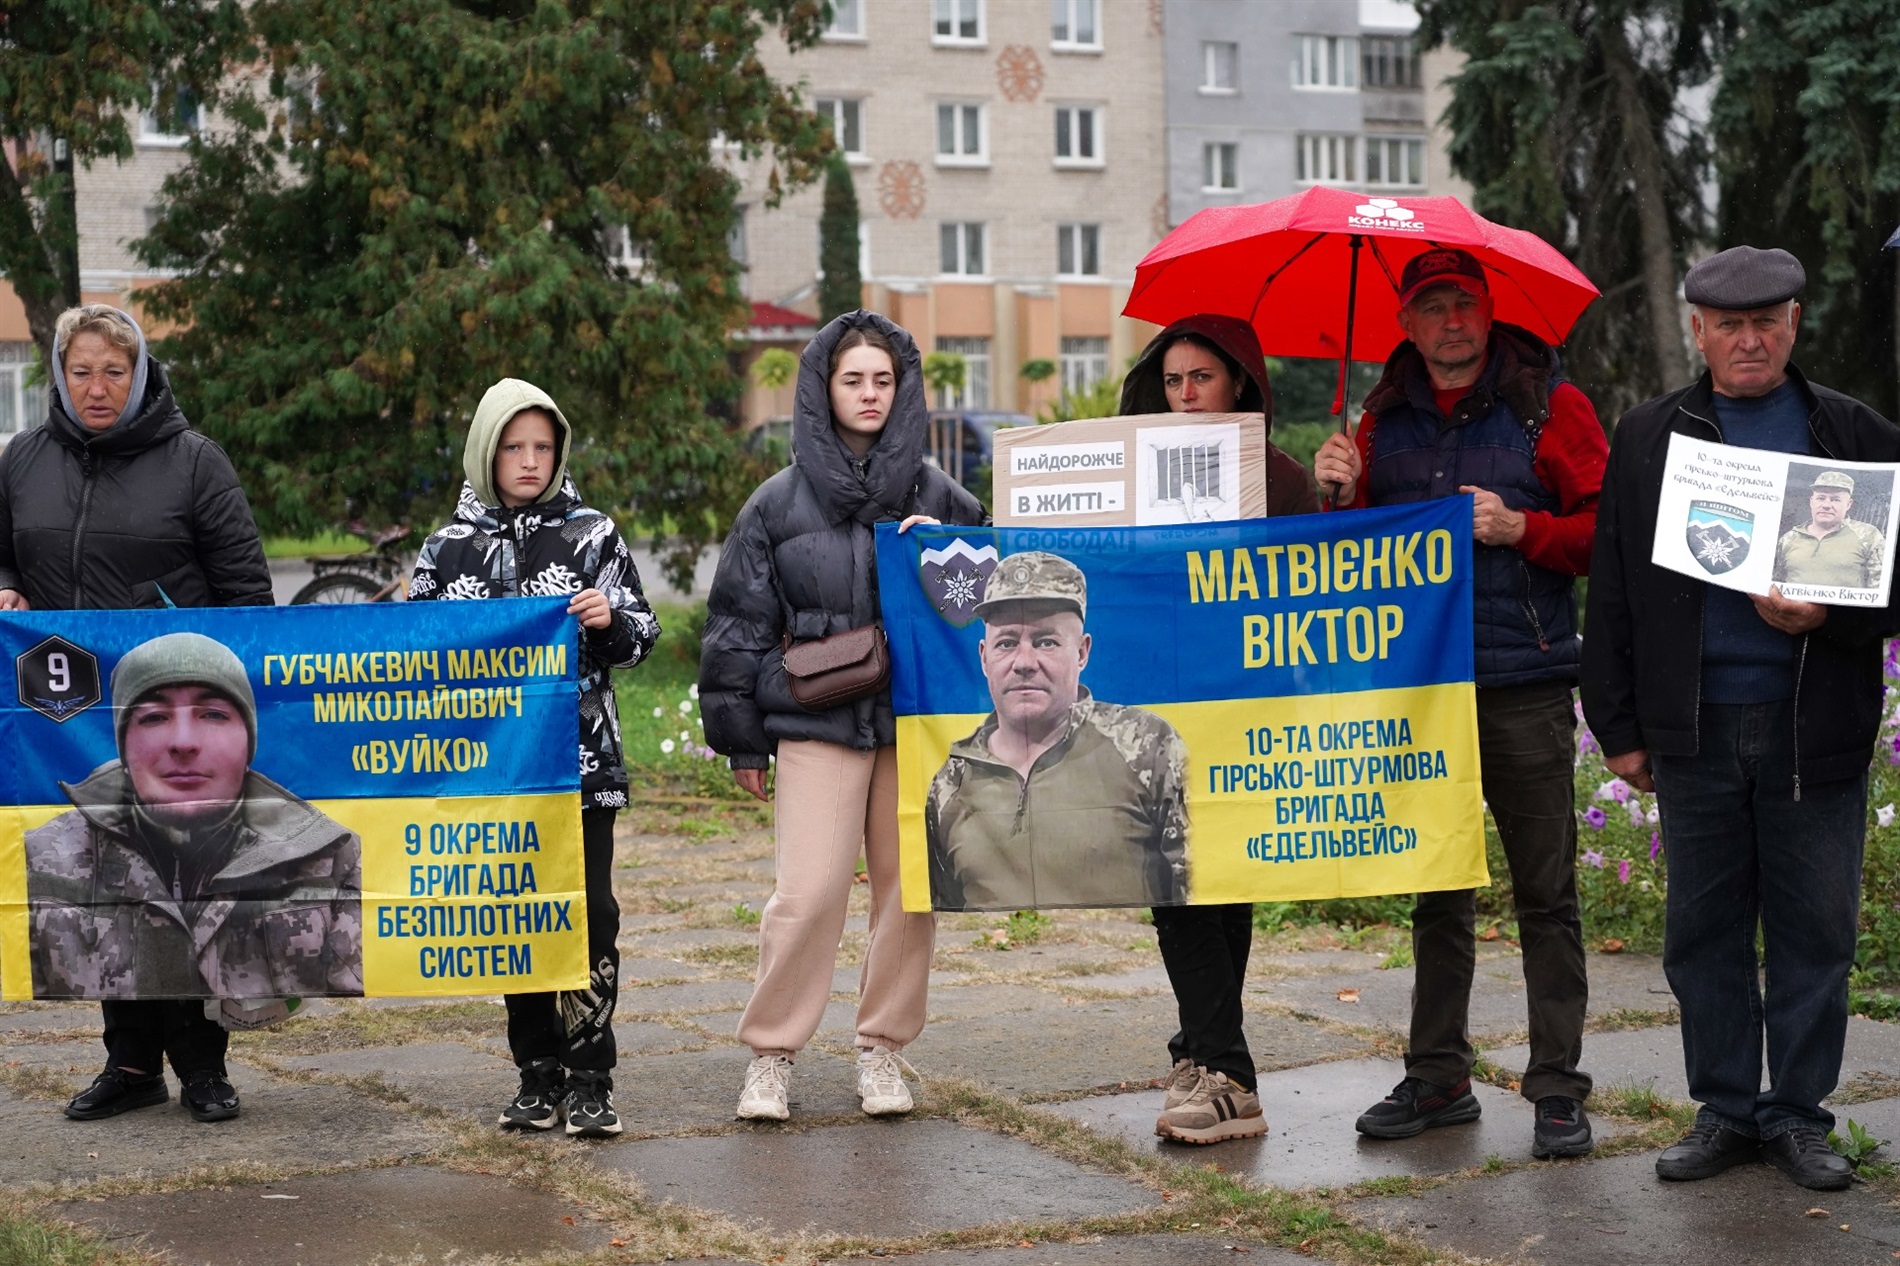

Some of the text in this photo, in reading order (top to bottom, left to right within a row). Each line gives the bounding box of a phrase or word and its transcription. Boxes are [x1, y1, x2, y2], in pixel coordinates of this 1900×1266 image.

[1348, 216, 1425, 229] КОНЕКС
[1017, 452, 1124, 471] НАЙДОРОЖЧЕ
[1684, 464, 1773, 488] гірсько-штурмова
[1697, 452, 1762, 473] 10-та окрема
[1017, 496, 1031, 513] В
[1037, 492, 1102, 512] ЖИТТІ
[1187, 529, 1452, 603] МАТВІЄНКО
[1839, 588, 1879, 603] Віктор
[1243, 605, 1403, 669] ВІКТОР
[48, 652, 71, 692] 9
[264, 645, 567, 686] ГУБЧАКЕВИЧ МАКСИМ
[313, 684, 521, 721] МИКОЛАЙОВИЧ
[352, 733, 488, 774] «ВУЙКО»
[1245, 718, 1415, 757] 10-ТА ОКРЕМА
[1209, 751, 1448, 794] ГІРСЬКО-ШТУРМОВА
[1275, 791, 1386, 826] БРИГАДА
[405, 820, 540, 856] 9 ОКРЕМА
[1246, 822, 1417, 864] «ЕДЕЛЬВЕЙС»
[410, 862, 537, 898] БРИГАДА
[377, 899, 572, 938] БЕЗПІЛОТНИХ
[419, 944, 532, 979] СИСТЕМ
